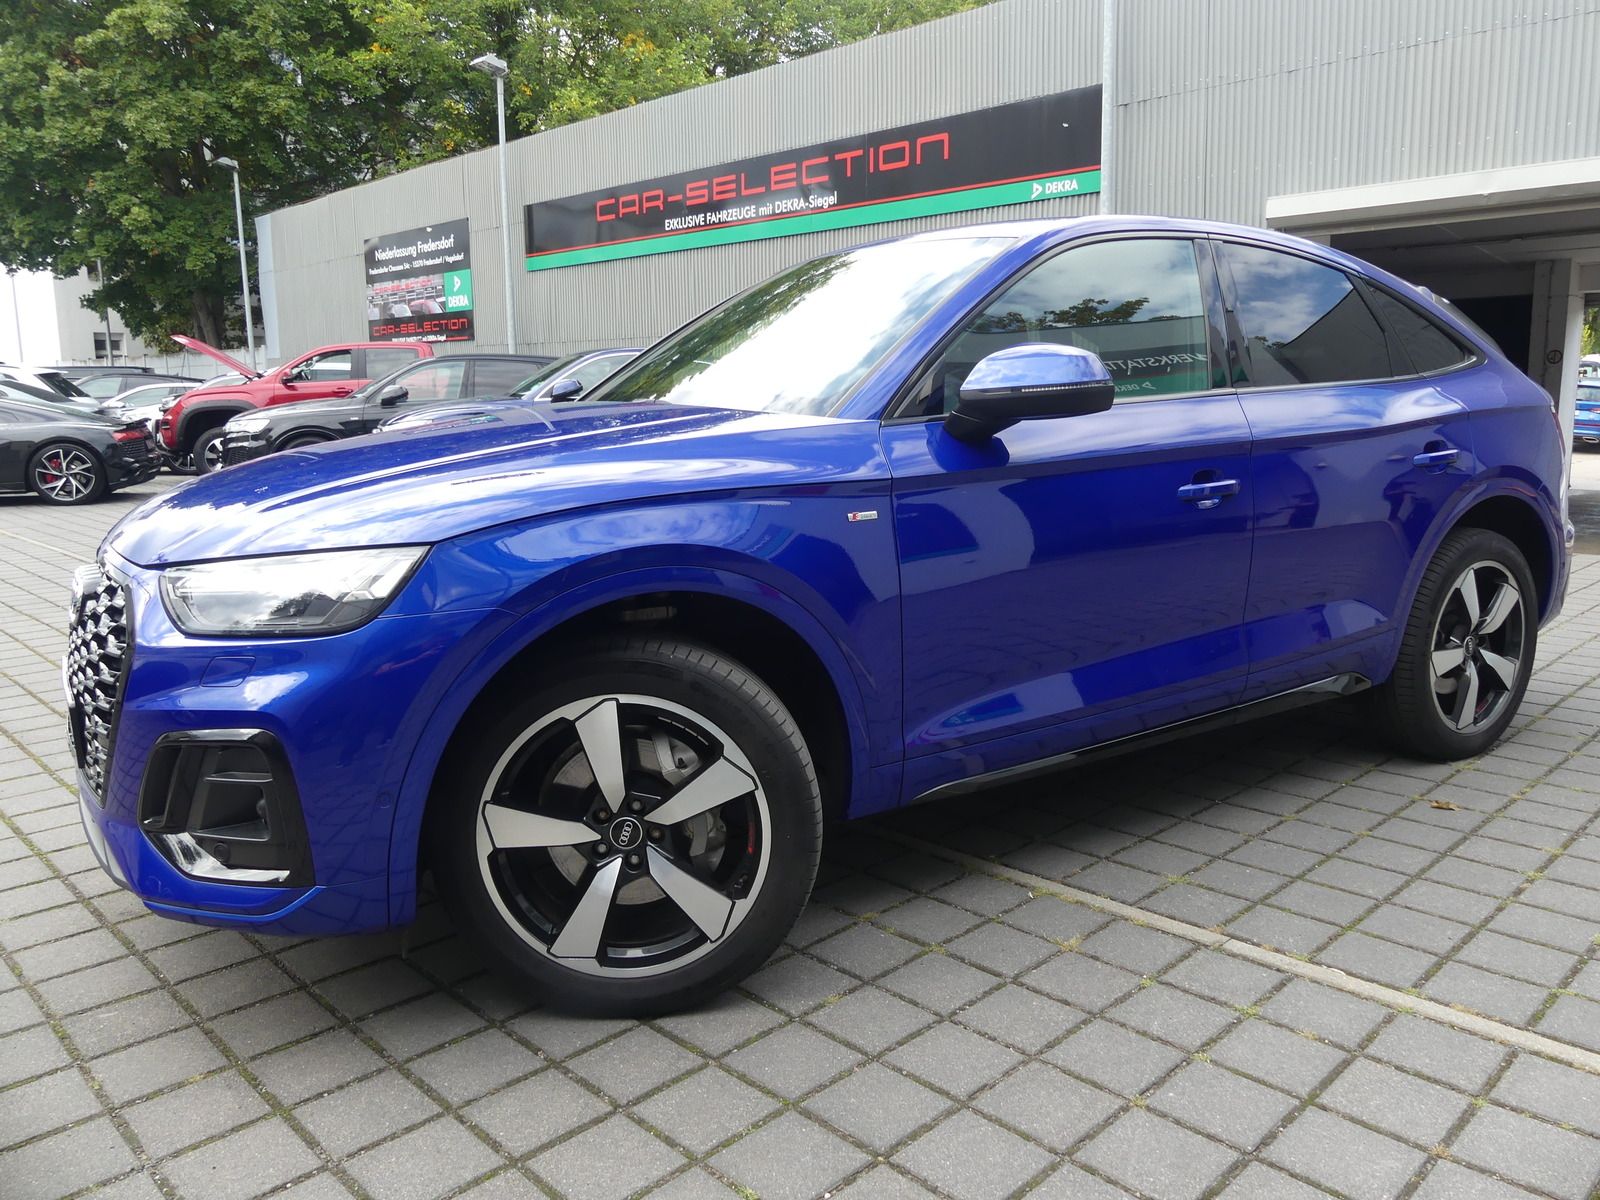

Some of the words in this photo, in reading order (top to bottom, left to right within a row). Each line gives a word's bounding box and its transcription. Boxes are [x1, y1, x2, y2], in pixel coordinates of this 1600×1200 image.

[595, 132, 949, 222] CAR-SELECTION
[1045, 178, 1079, 195] DEKRA
[664, 213, 705, 231] EXKLUSIVE
[706, 205, 756, 224] FAHRZEUGE
[758, 203, 773, 217] mit
[774, 191, 838, 214] DEKRA-Siegel
[374, 245, 417, 262] Niederlassung
[417, 233, 454, 254] Fredersdorf
[448, 294, 469, 308] DEKRA
[372, 318, 468, 337] CAR-SELECTION
